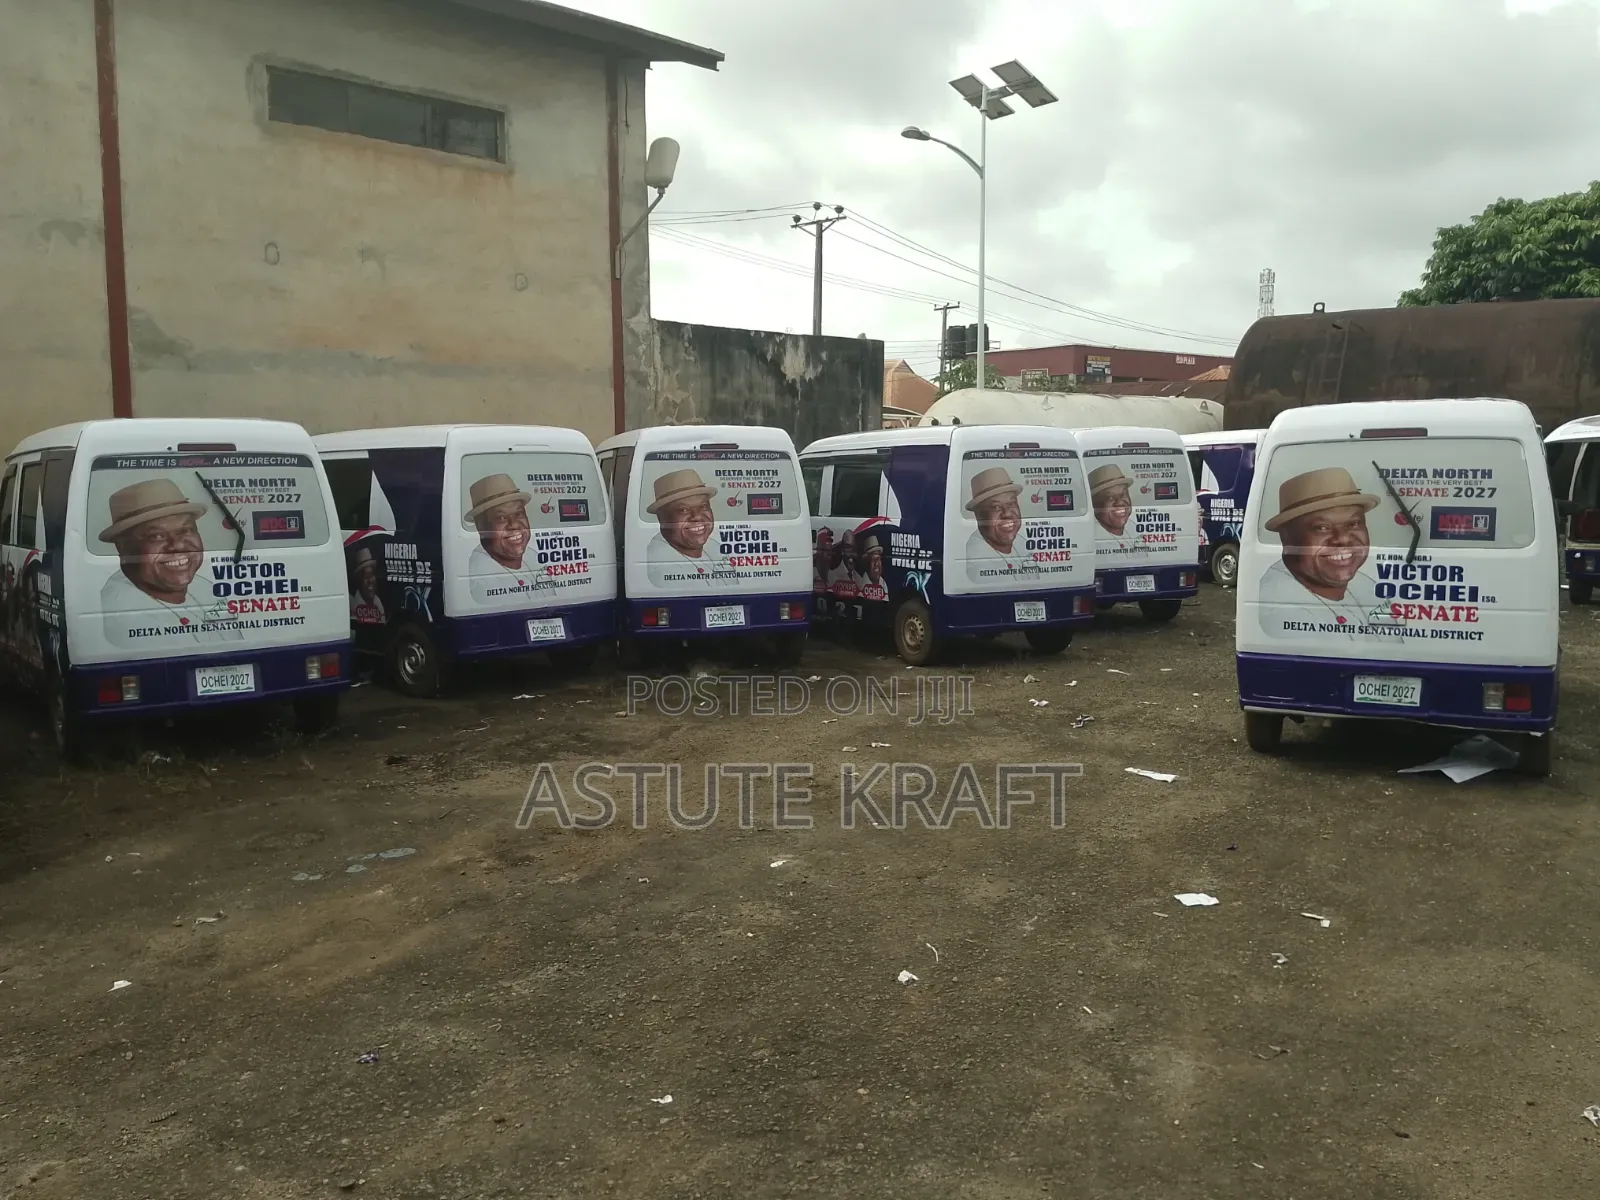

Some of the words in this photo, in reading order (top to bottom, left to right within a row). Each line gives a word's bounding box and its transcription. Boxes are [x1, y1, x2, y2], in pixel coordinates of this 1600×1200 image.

[116, 459, 137, 468] THE
[140, 458, 164, 467] TIME
[166, 458, 177, 467] IS
[213, 457, 221, 465] A
[222, 457, 243, 465] NEW
[243, 456, 298, 465] DIRECTION
[554, 473, 583, 481] NORTH
[715, 469, 744, 477] DELTA
[1379, 468, 1428, 479] DELTA
[1432, 468, 1493, 479] NORTH
[203, 478, 246, 488] DELTA
[248, 477, 297, 487] NORTH
[727, 481, 756, 489] SENATE
[223, 495, 265, 504] SENATE
[267, 493, 302, 504] 2027
[1399, 487, 1449, 497] SENATE
[1452, 487, 1497, 498] 2027
[1210, 498, 1235, 508] NIGERIA
[1136, 513, 1170, 522] VICTOR
[1025, 526, 1064, 538] VICTOR
[1136, 523, 1176, 533] OCHEI
[719, 530, 769, 542] VICTOR
[890, 532, 921, 549] NIGERIA
[1142, 533, 1176, 543] SENATE
[536, 535, 580, 551] VICTOR
[720, 542, 778, 554] OCHEI
[1025, 538, 1071, 550] OCHEI
[384, 543, 418, 560] NIGERIA
[537, 548, 588, 564] OCHEI
[1032, 551, 1071, 562] SENATE
[729, 555, 779, 567] SENATE
[212, 562, 286, 580] VICTOR
[546, 562, 589, 576] SENATE
[686, 572, 710, 580] NORTH
[752, 570, 782, 578] DISTRICT
[1050, 565, 1073, 573] DISTRICT
[1376, 563, 1464, 583] VICTOR
[212, 579, 299, 597] OCHEI
[487, 588, 508, 596] DELTA
[508, 585, 530, 594] NORTH
[567, 577, 592, 587] DISTRICT
[864, 586, 884, 597] OCHEI
[1375, 582, 1479, 603] OCHEI
[1482, 595, 1497, 604] ESQ.
[227, 596, 301, 614] SENATE
[708, 613, 727, 623] OCHEI
[727, 611, 741, 622] 2027
[1017, 608, 1032, 617] OCHEI
[1390, 602, 1480, 623] SENATE
[128, 628, 162, 638] DELTA
[163, 625, 199, 635] NORTH
[200, 620, 262, 632] SENATORIAL
[263, 616, 305, 628] DISTRICT
[532, 625, 550, 636] OCHEI
[1283, 621, 1317, 632] DELTA
[1318, 623, 1356, 634] NORTH
[1357, 625, 1429, 638] SENATORIAL
[1430, 628, 1484, 641] DISTRICT
[200, 674, 229, 688] OCHEI
[230, 673, 250, 686] 2027
[1358, 682, 1390, 697] OCHEI
[1392, 684, 1415, 699] 2027
